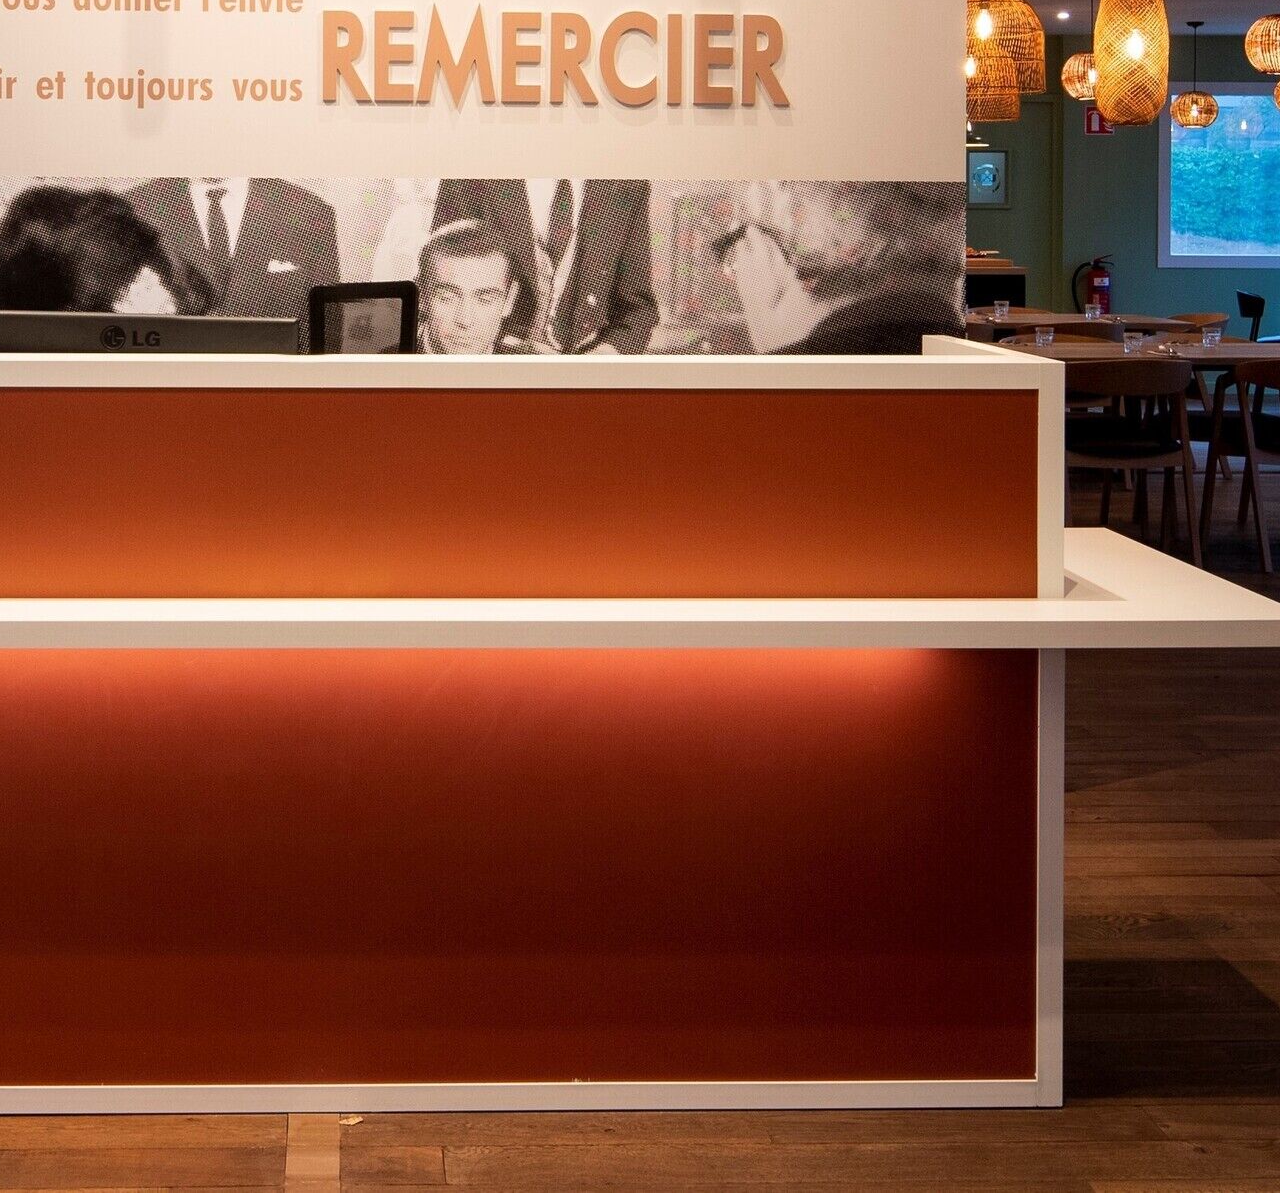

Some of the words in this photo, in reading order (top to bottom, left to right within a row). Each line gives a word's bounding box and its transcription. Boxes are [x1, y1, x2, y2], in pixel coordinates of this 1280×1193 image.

[321, 3, 791, 111] REMERCIER
[34, 70, 66, 101] et
[83, 68, 215, 110] toujours
[231, 77, 304, 103] vous
[132, 331, 160, 346] LG
